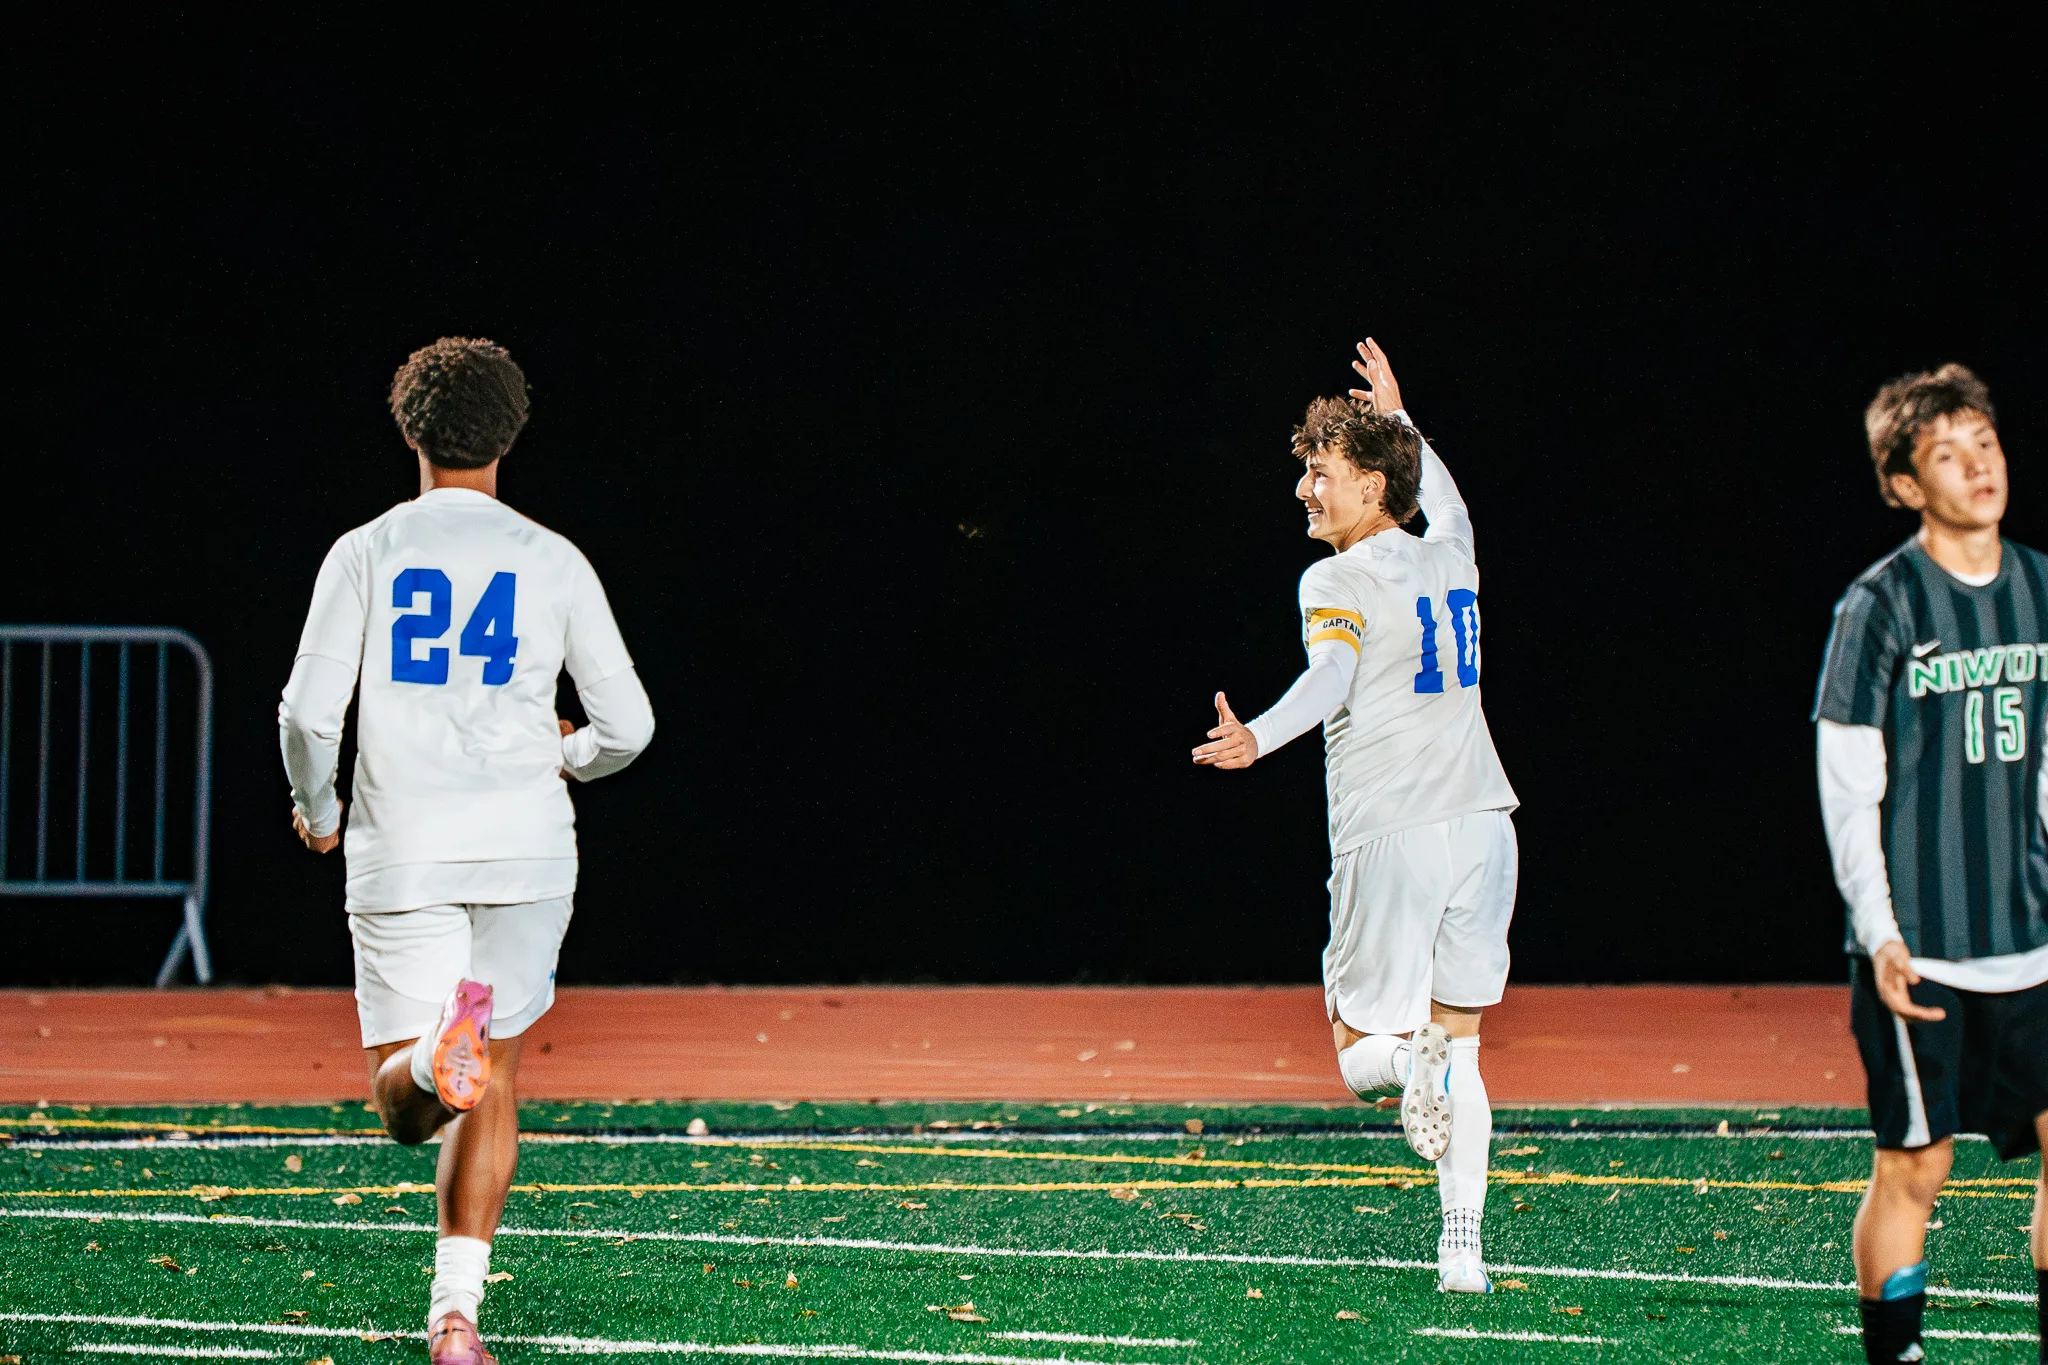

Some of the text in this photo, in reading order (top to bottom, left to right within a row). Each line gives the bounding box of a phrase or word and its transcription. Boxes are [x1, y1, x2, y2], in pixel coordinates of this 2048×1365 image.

[391, 568, 519, 686] 24
[1323, 618, 1361, 640] CAPTAIN
[1414, 588, 1478, 694] 10
[1965, 686, 2025, 764] 15
